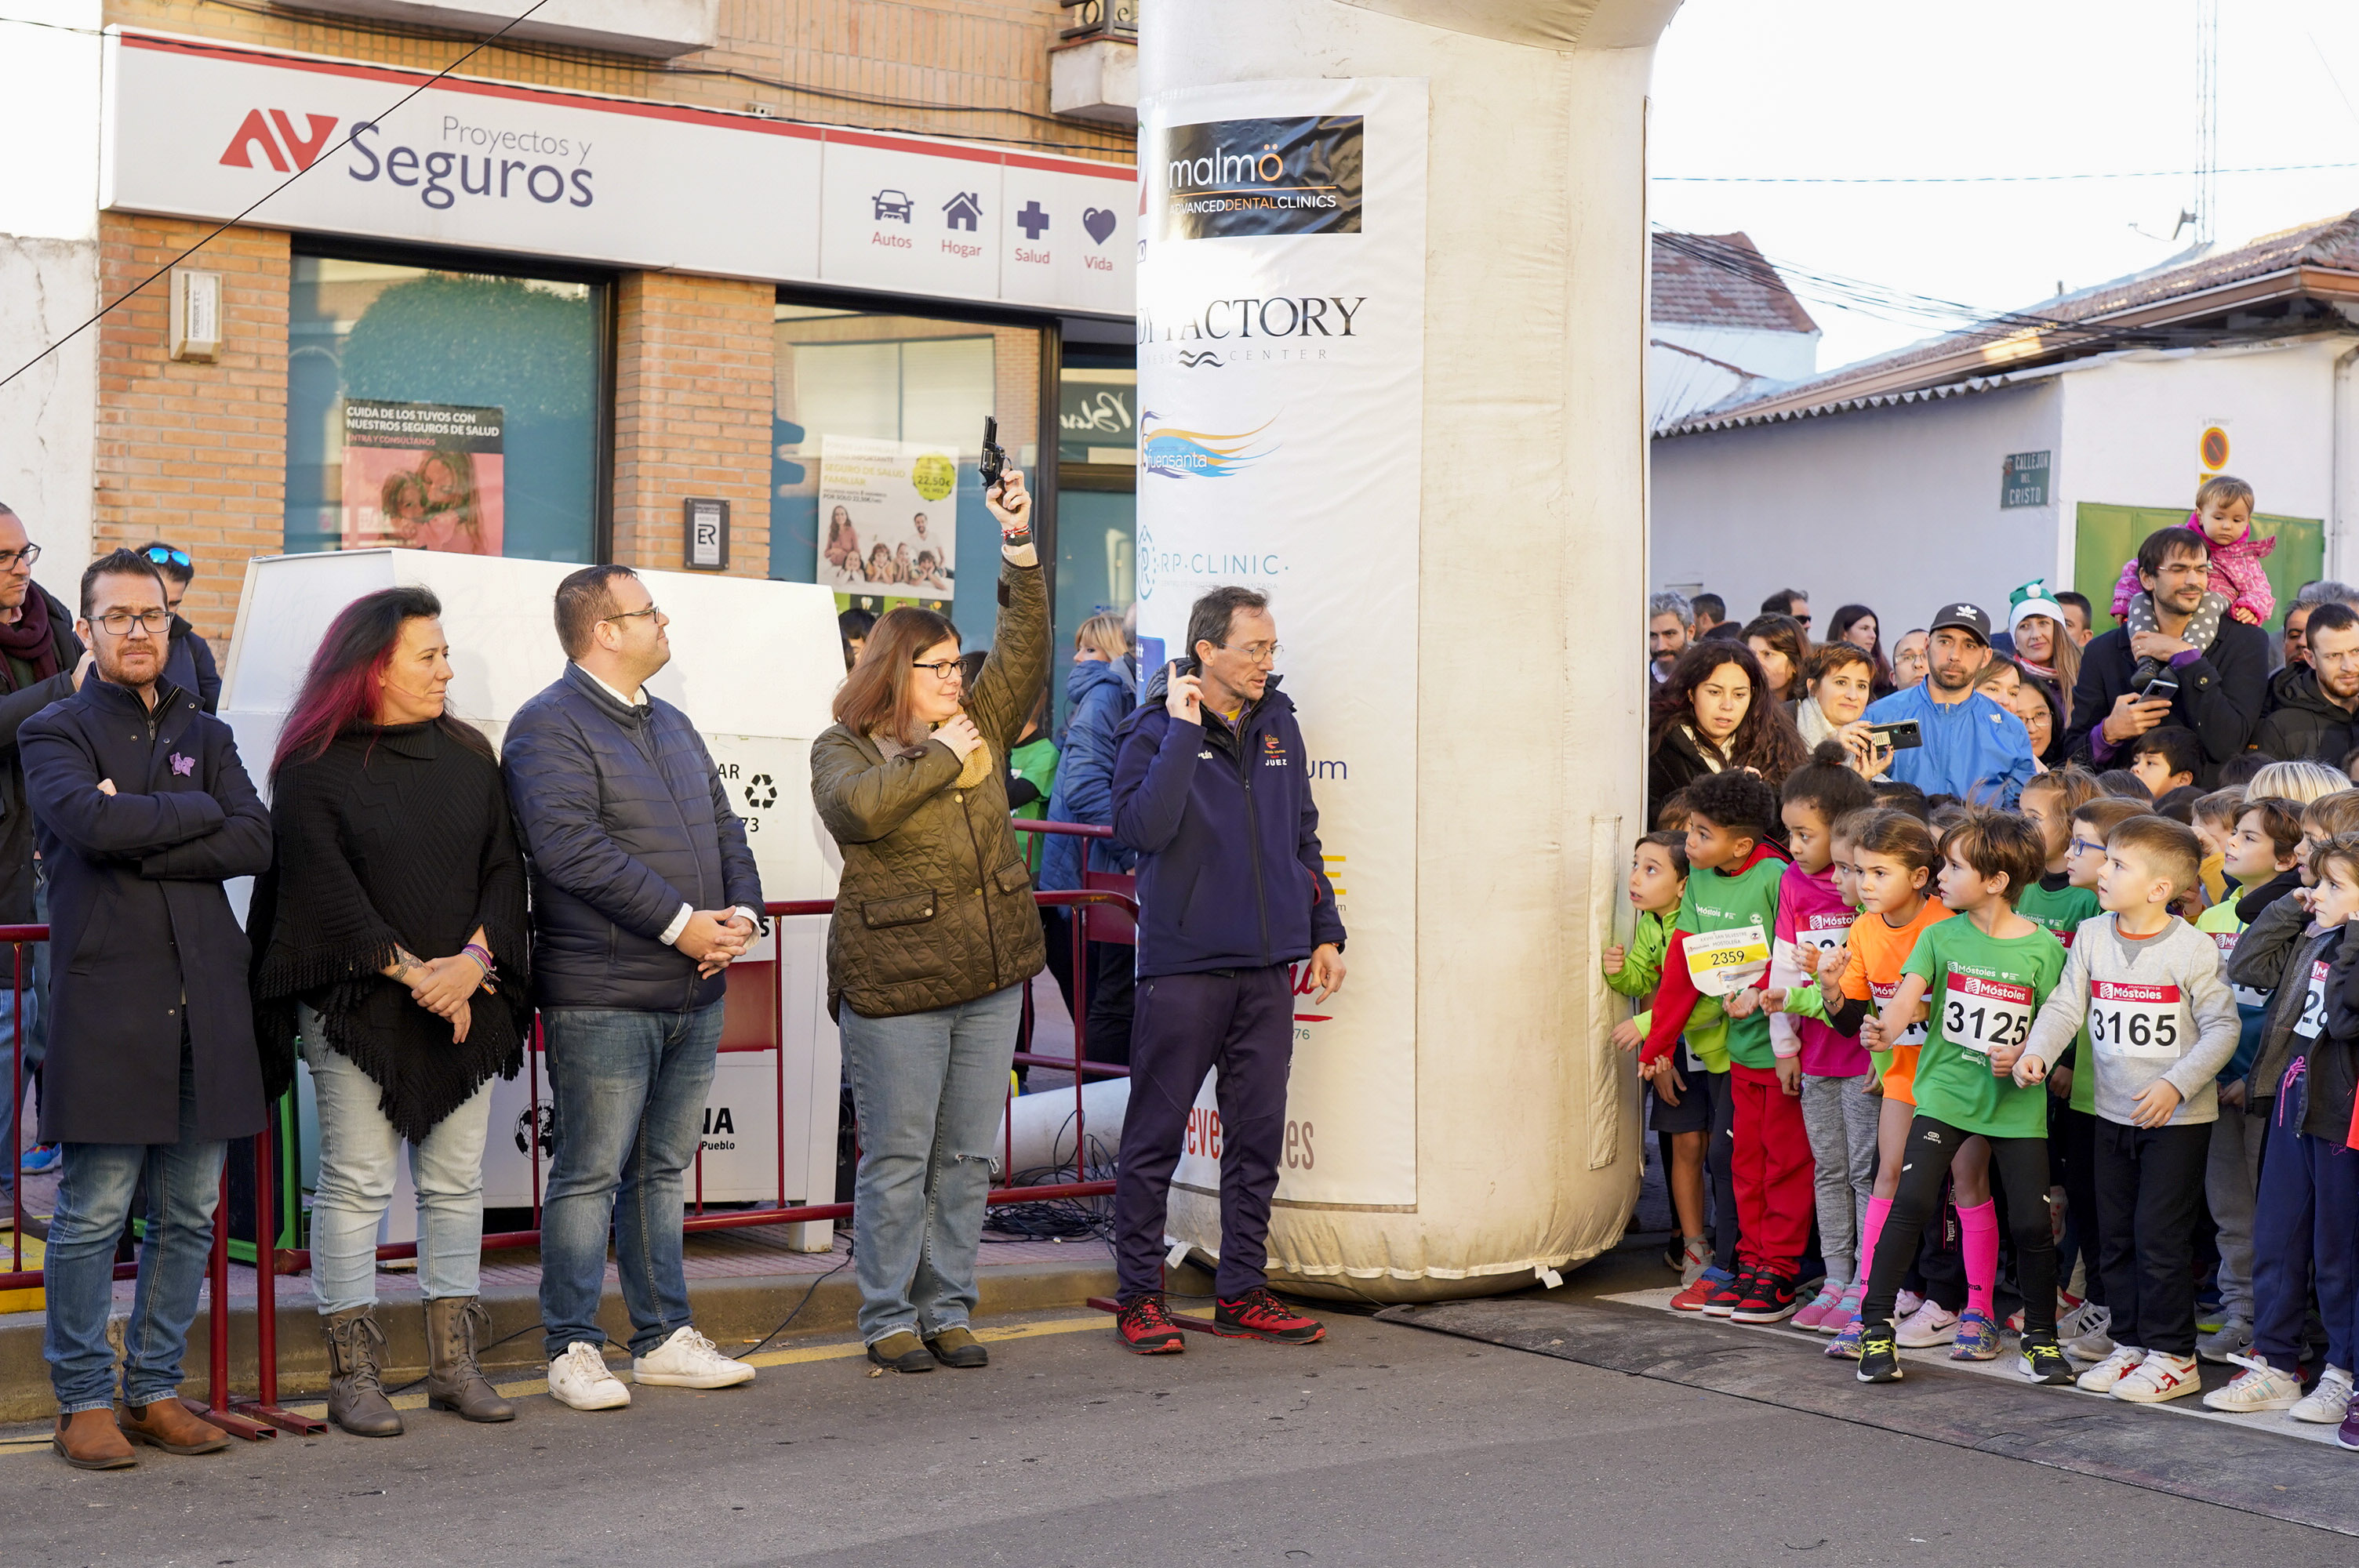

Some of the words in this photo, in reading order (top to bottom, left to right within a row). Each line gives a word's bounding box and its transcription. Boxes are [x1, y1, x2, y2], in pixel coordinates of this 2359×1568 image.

[442, 115, 569, 157] Proyectos
[579, 141, 593, 165] y
[347, 122, 594, 209] Seguros
[1169, 143, 1284, 188] malmö
[872, 232, 912, 249] Autos
[942, 240, 982, 258] Hogar
[1015, 249, 1050, 264] Salud
[1085, 256, 1113, 271] Vida
[1230, 349, 1326, 361] CENTER
[347, 406, 379, 418] CUIDA
[380, 408, 394, 419] DE
[396, 409, 416, 420] LOS
[416, 411, 451, 422] TUYOS
[453, 412, 475, 423] CON
[347, 419, 401, 432] NUESTROS
[402, 421, 449, 434] SEGUROS
[450, 424, 464, 435] DE
[466, 426, 500, 437] SALUD
[347, 434, 373, 443] ENTRA
[2009, 487, 2041, 505] CRISTO
[698, 524, 716, 545] ER
[718, 764, 740, 779] AR
[740, 817, 759, 832] 73
[1710, 950, 1744, 966] 2359
[1959, 964, 1996, 977] Móstoles
[1981, 983, 2026, 1001] Móstoles
[2114, 987, 2162, 1000] Móstoles
[1946, 1001, 2028, 1047] 3125
[2093, 1008, 2176, 1047] 3165
[1294, 1028, 1310, 1040] 76
[701, 1141, 735, 1150] Pueblo
